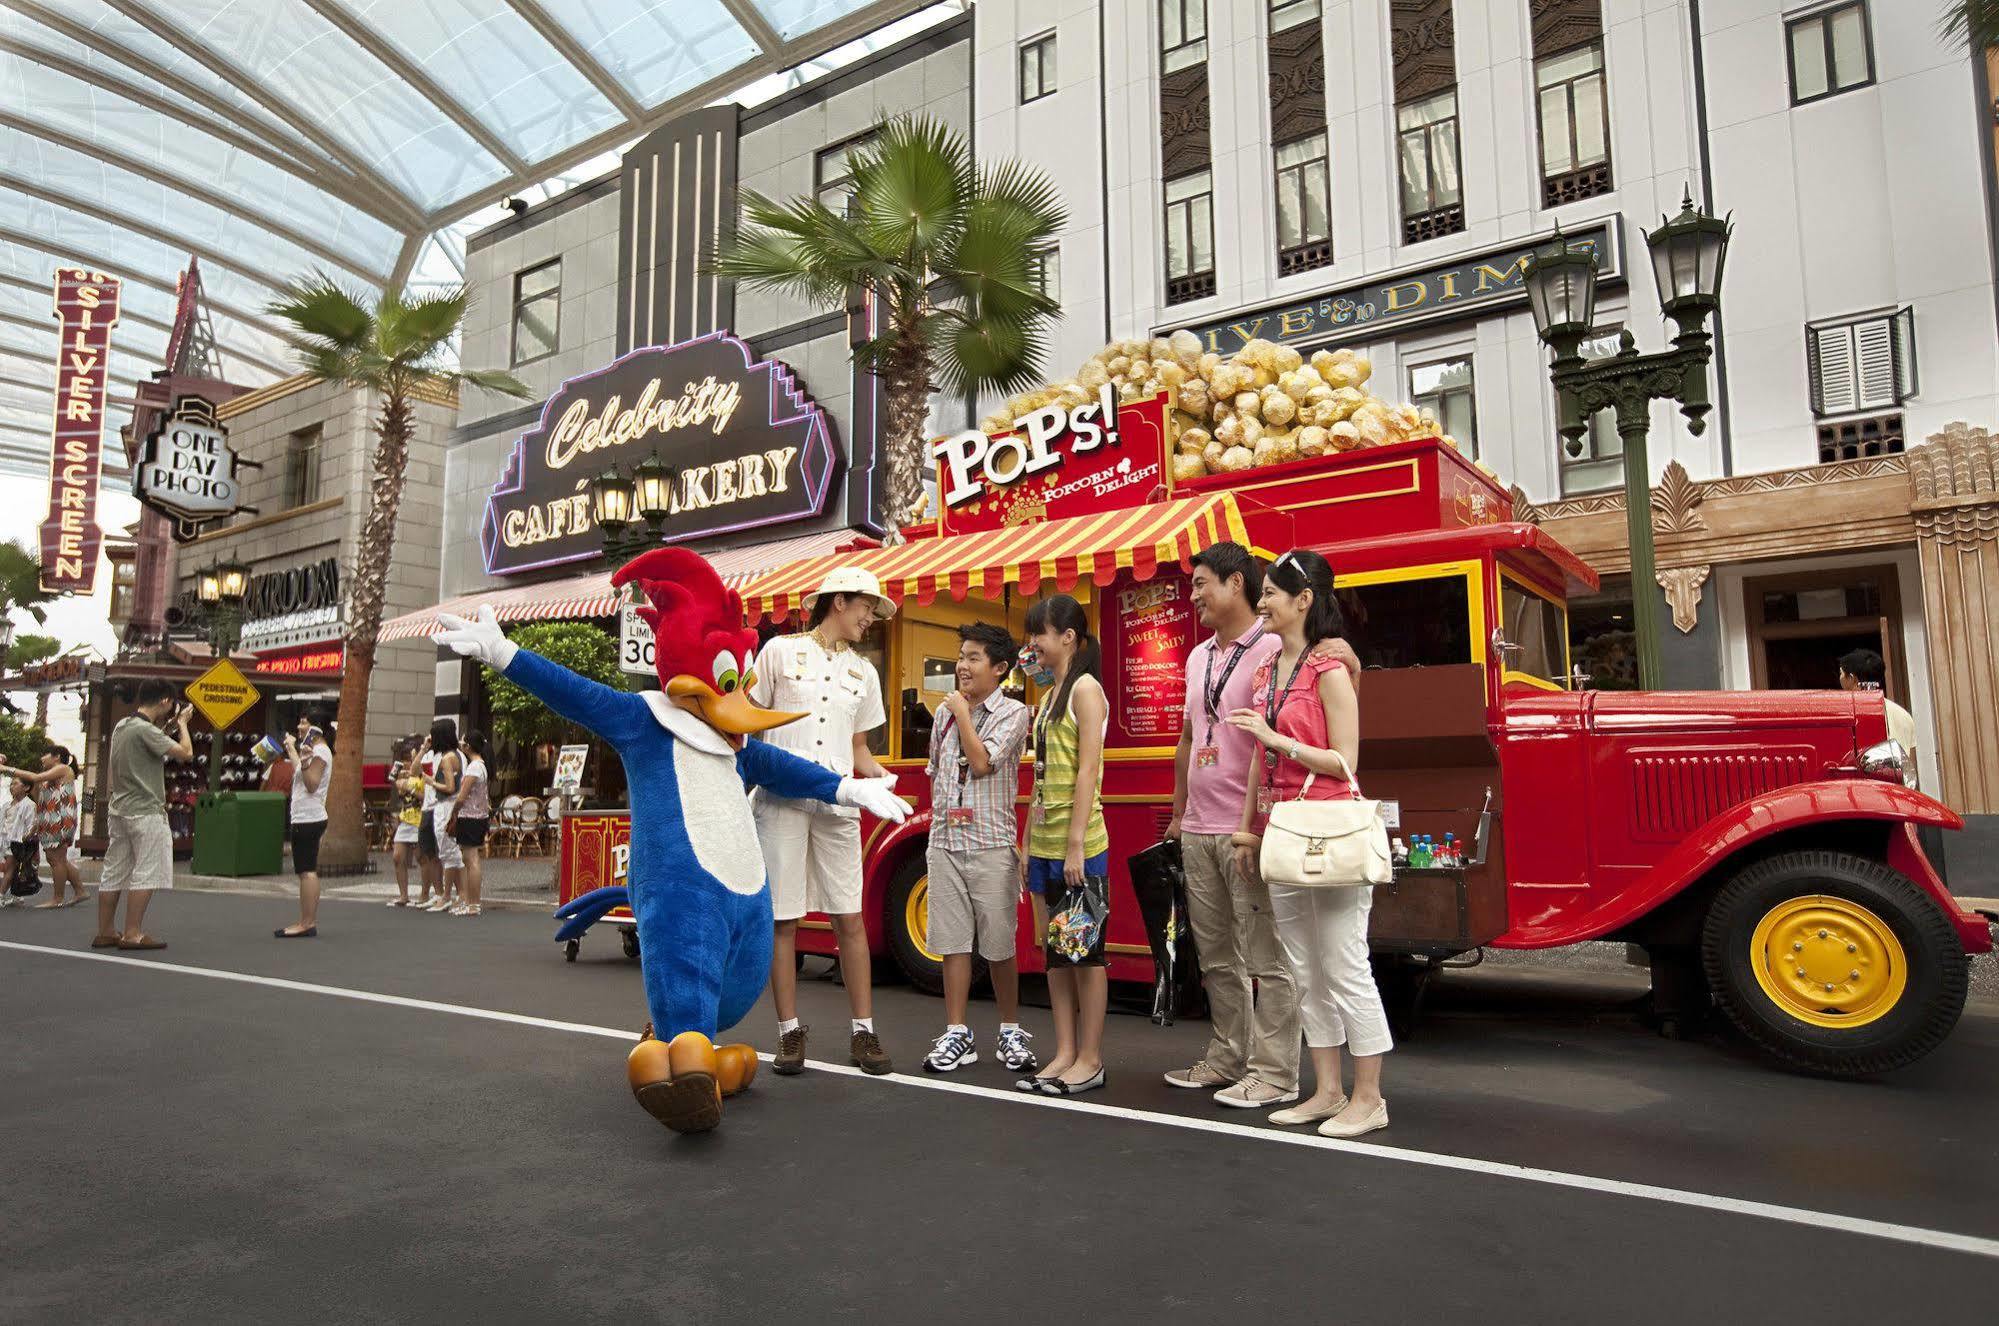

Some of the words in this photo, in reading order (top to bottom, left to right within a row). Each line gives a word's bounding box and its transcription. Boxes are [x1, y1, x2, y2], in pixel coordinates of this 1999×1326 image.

[1204, 306, 1315, 353] IVE
[67, 286, 100, 423] SILVER
[546, 376, 742, 470] Celebrity
[172, 430, 221, 456] ONE
[173, 451, 217, 476] DAY
[154, 469, 231, 500] PHOTO
[502, 478, 591, 547] CAFÉ
[627, 447, 797, 522] KERY
[55, 440, 88, 580] SCREEN
[200, 683, 248, 694] PEDESTRIAN
[204, 693, 243, 704] CROSSING
[612, 843, 630, 879] P
